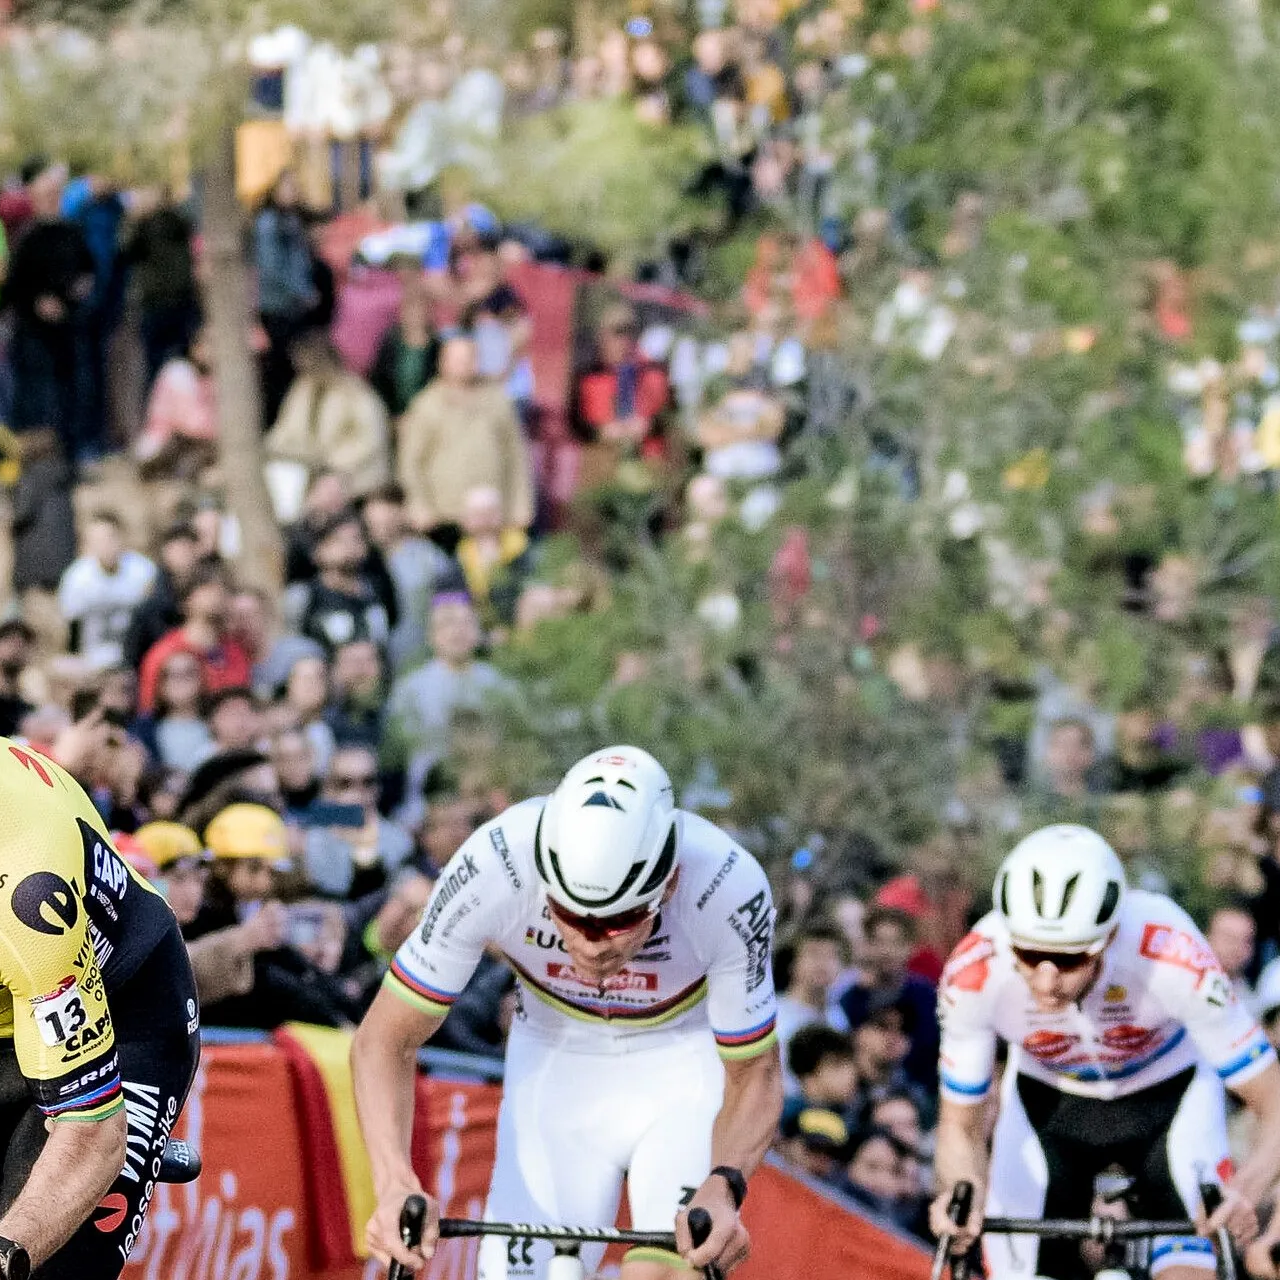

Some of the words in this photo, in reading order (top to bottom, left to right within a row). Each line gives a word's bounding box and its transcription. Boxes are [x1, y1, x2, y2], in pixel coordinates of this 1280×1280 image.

[93, 842, 128, 900] CAPS
[45, 996, 87, 1043] 13
[65, 1008, 112, 1052] CAPS
[121, 1081, 160, 1183] VISMA
